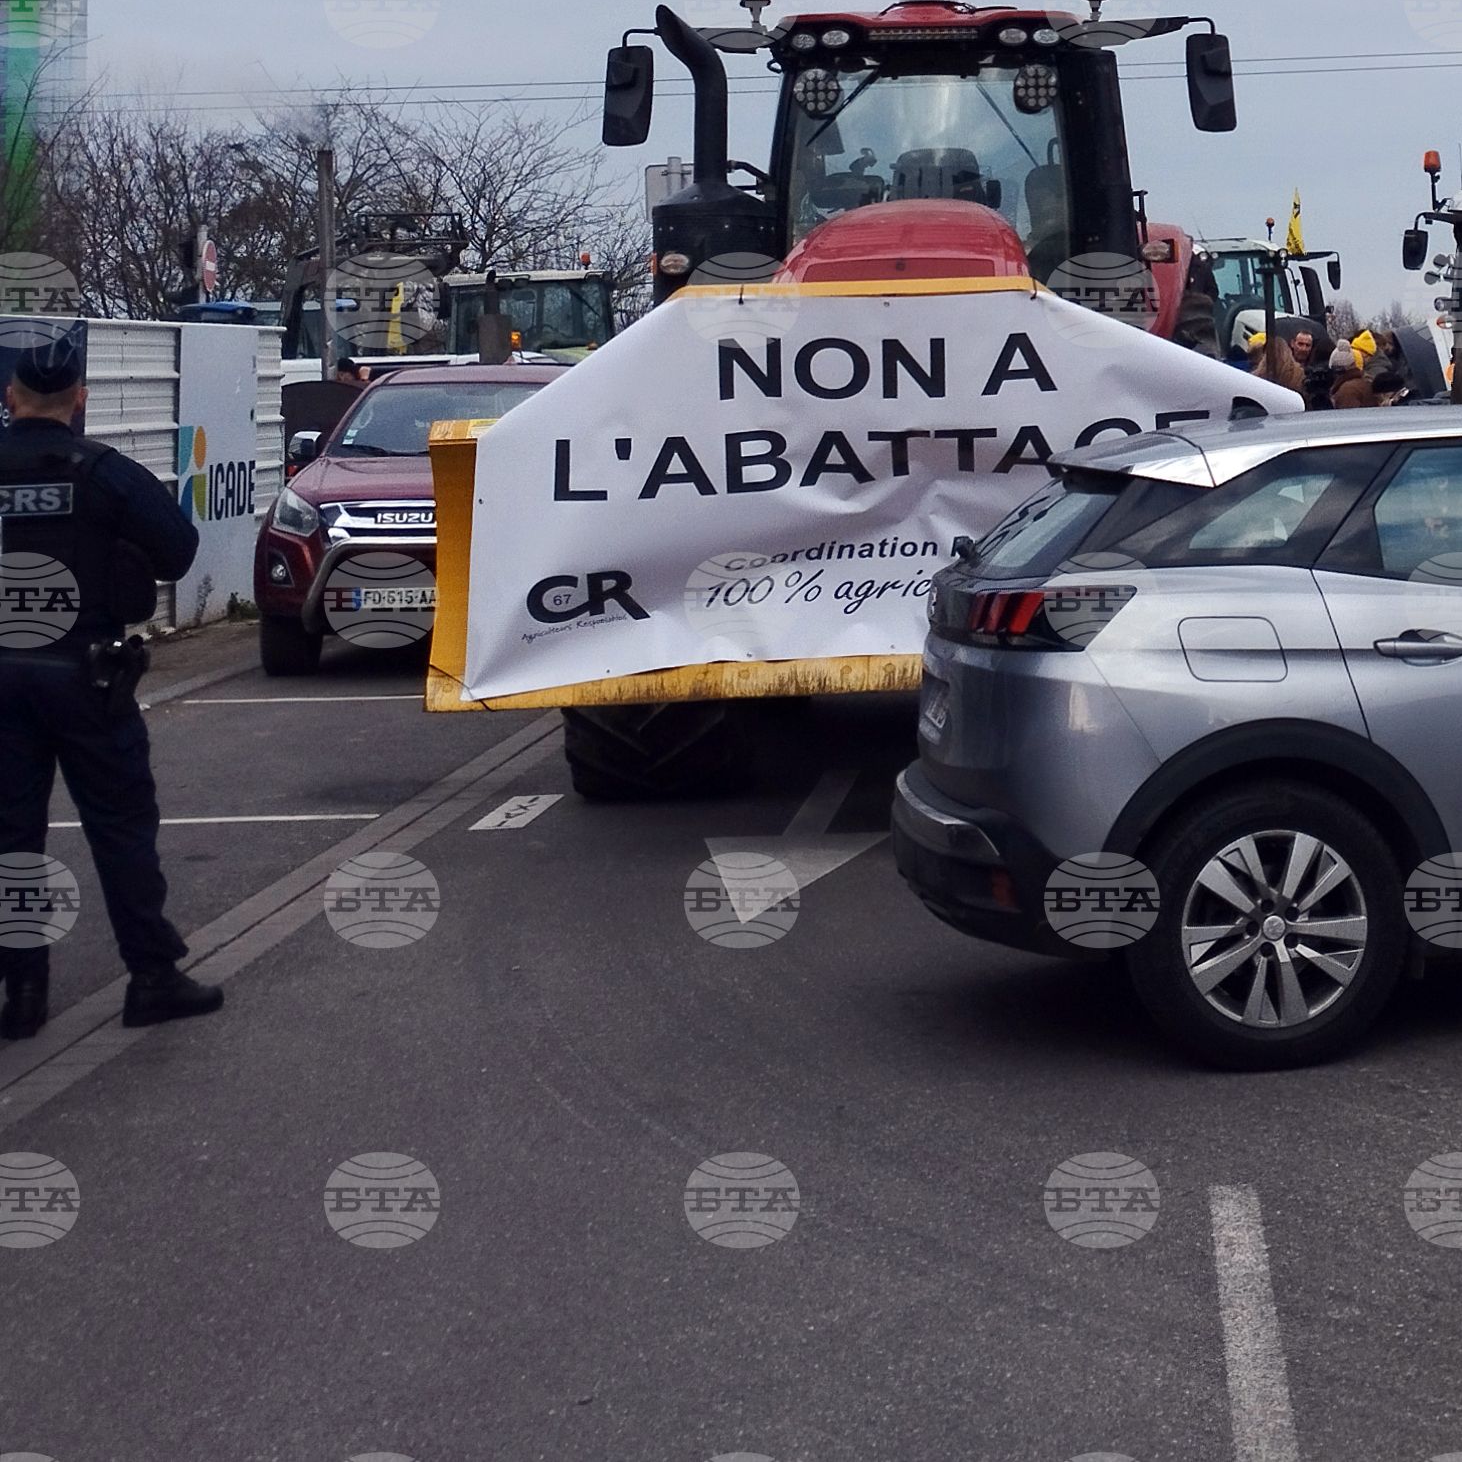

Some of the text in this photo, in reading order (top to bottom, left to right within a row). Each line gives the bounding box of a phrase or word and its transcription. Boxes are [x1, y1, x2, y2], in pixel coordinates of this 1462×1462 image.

[718, 332, 1058, 401] NON A
[553, 410, 1211, 502] L'ABATTA
[209, 459, 256, 521] ICADE
[376, 511, 434, 524] ISUZU
[527, 570, 651, 624] CR
[553, 594, 572, 606] 67
